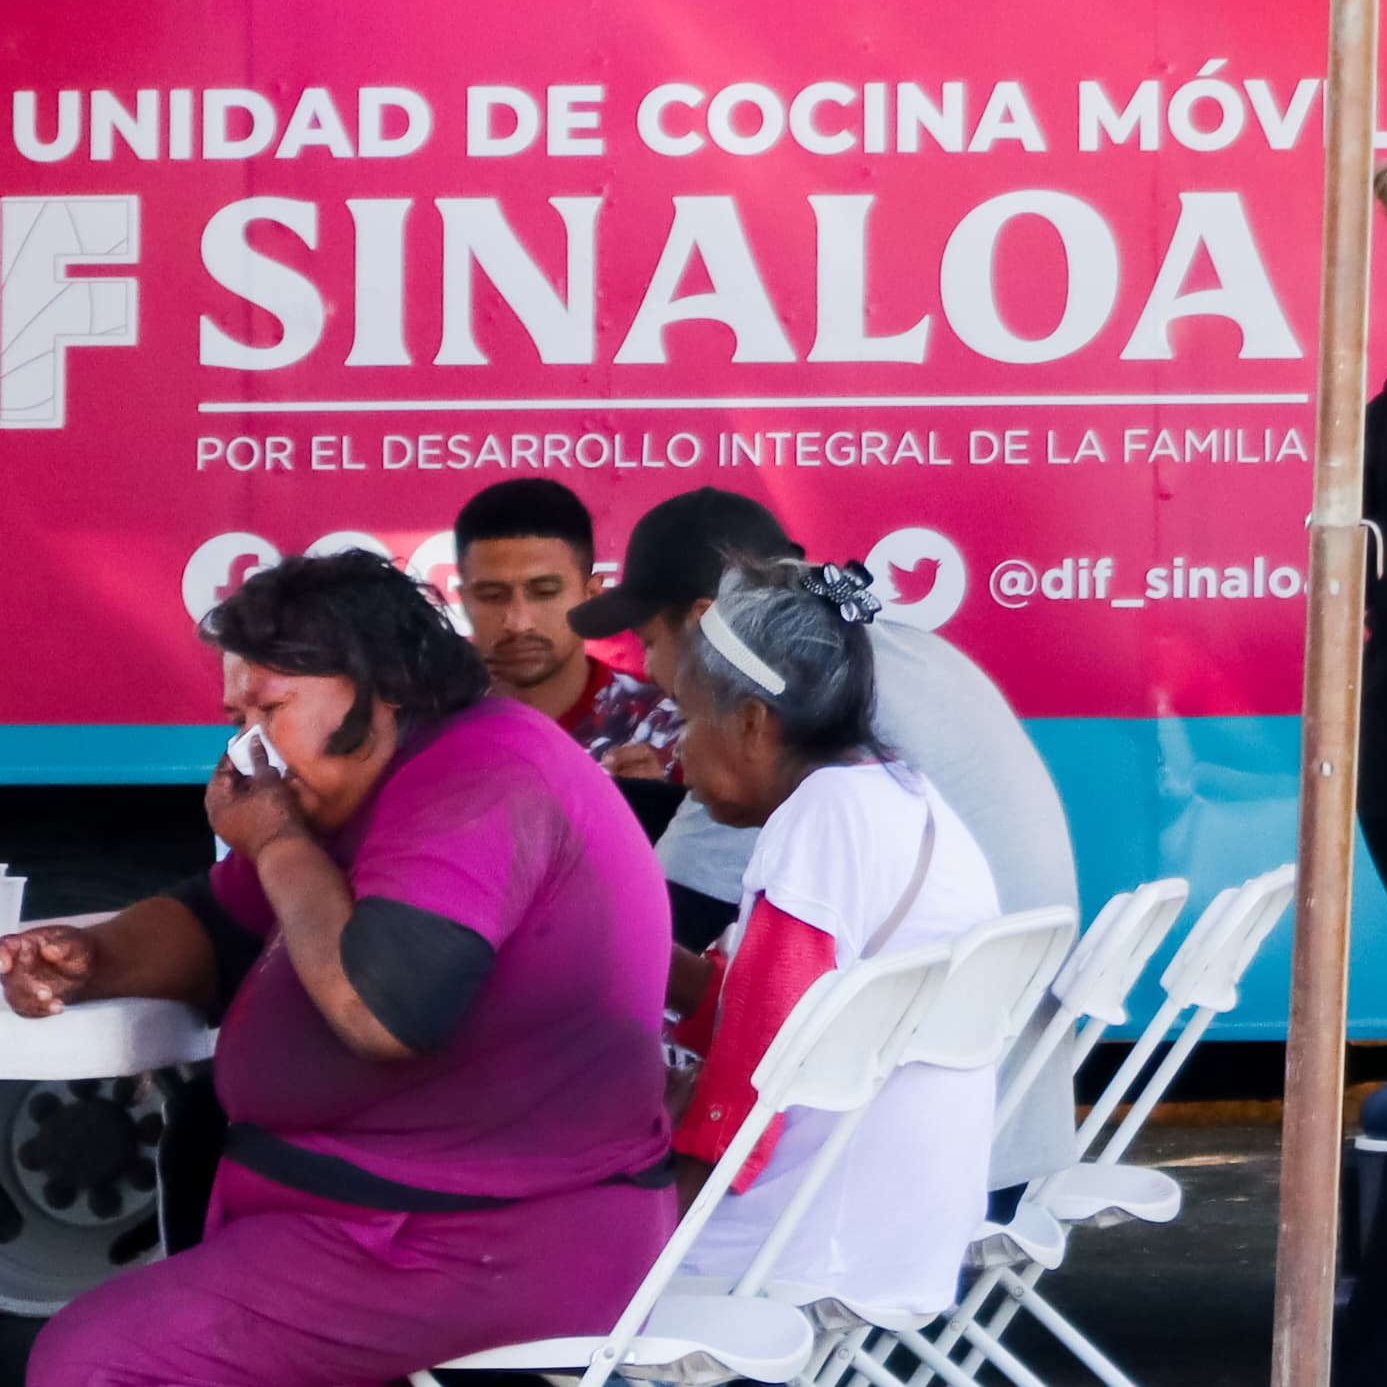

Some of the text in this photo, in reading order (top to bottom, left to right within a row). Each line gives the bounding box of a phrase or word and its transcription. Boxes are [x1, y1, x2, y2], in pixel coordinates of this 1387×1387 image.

[12, 86, 434, 162] UNIDAD
[466, 84, 606, 157] DE
[636, 80, 1048, 157] COCINA
[198, 188, 1305, 371] SINALOA
[196, 428, 1308, 471] POR EL DESARROLLO INTEGRAL DE LA FAMILIA
[989, 556, 1308, 609] @dif_sinalo
